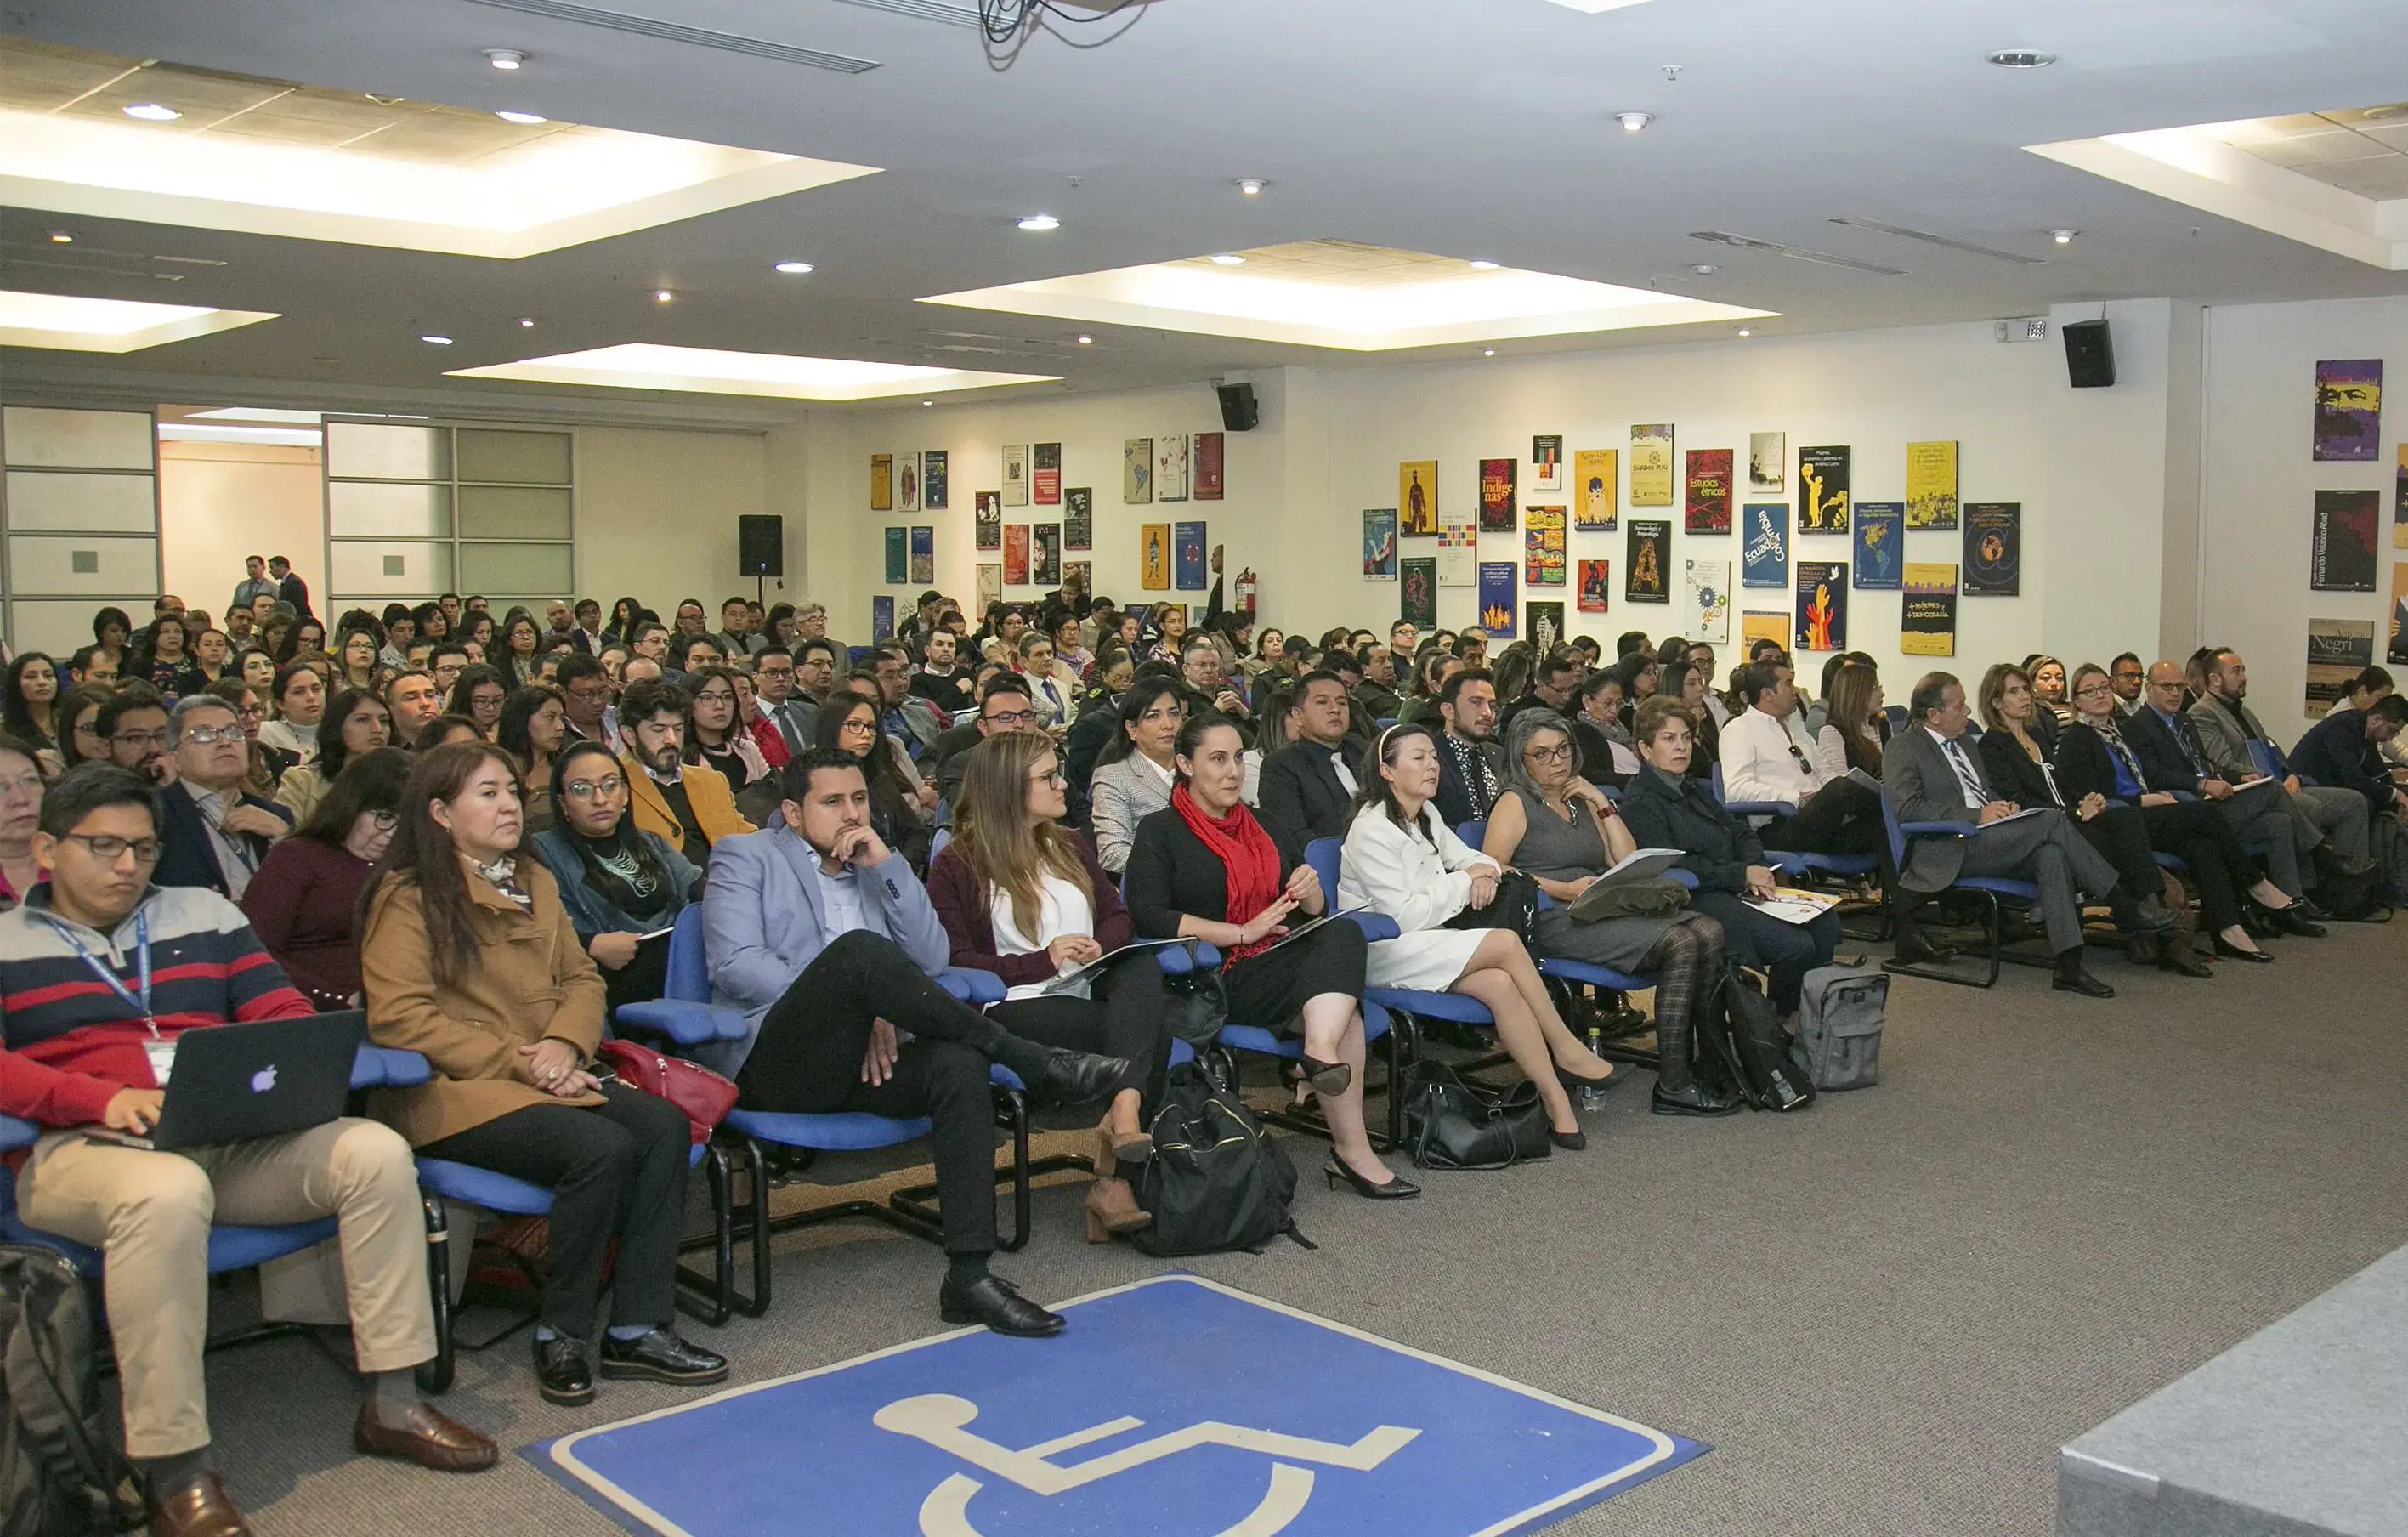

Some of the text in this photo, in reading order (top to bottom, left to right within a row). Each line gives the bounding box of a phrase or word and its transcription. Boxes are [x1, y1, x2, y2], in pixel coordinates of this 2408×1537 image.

[1690, 478, 1719, 488] Estudios
[1484, 491, 1502, 502] nas
[1701, 487, 1726, 496] étnicos
[1759, 509, 1785, 562] Colombia
[2317, 512, 2328, 587] Fernando Velasco Abad
[2311, 635, 2353, 655] Negri
